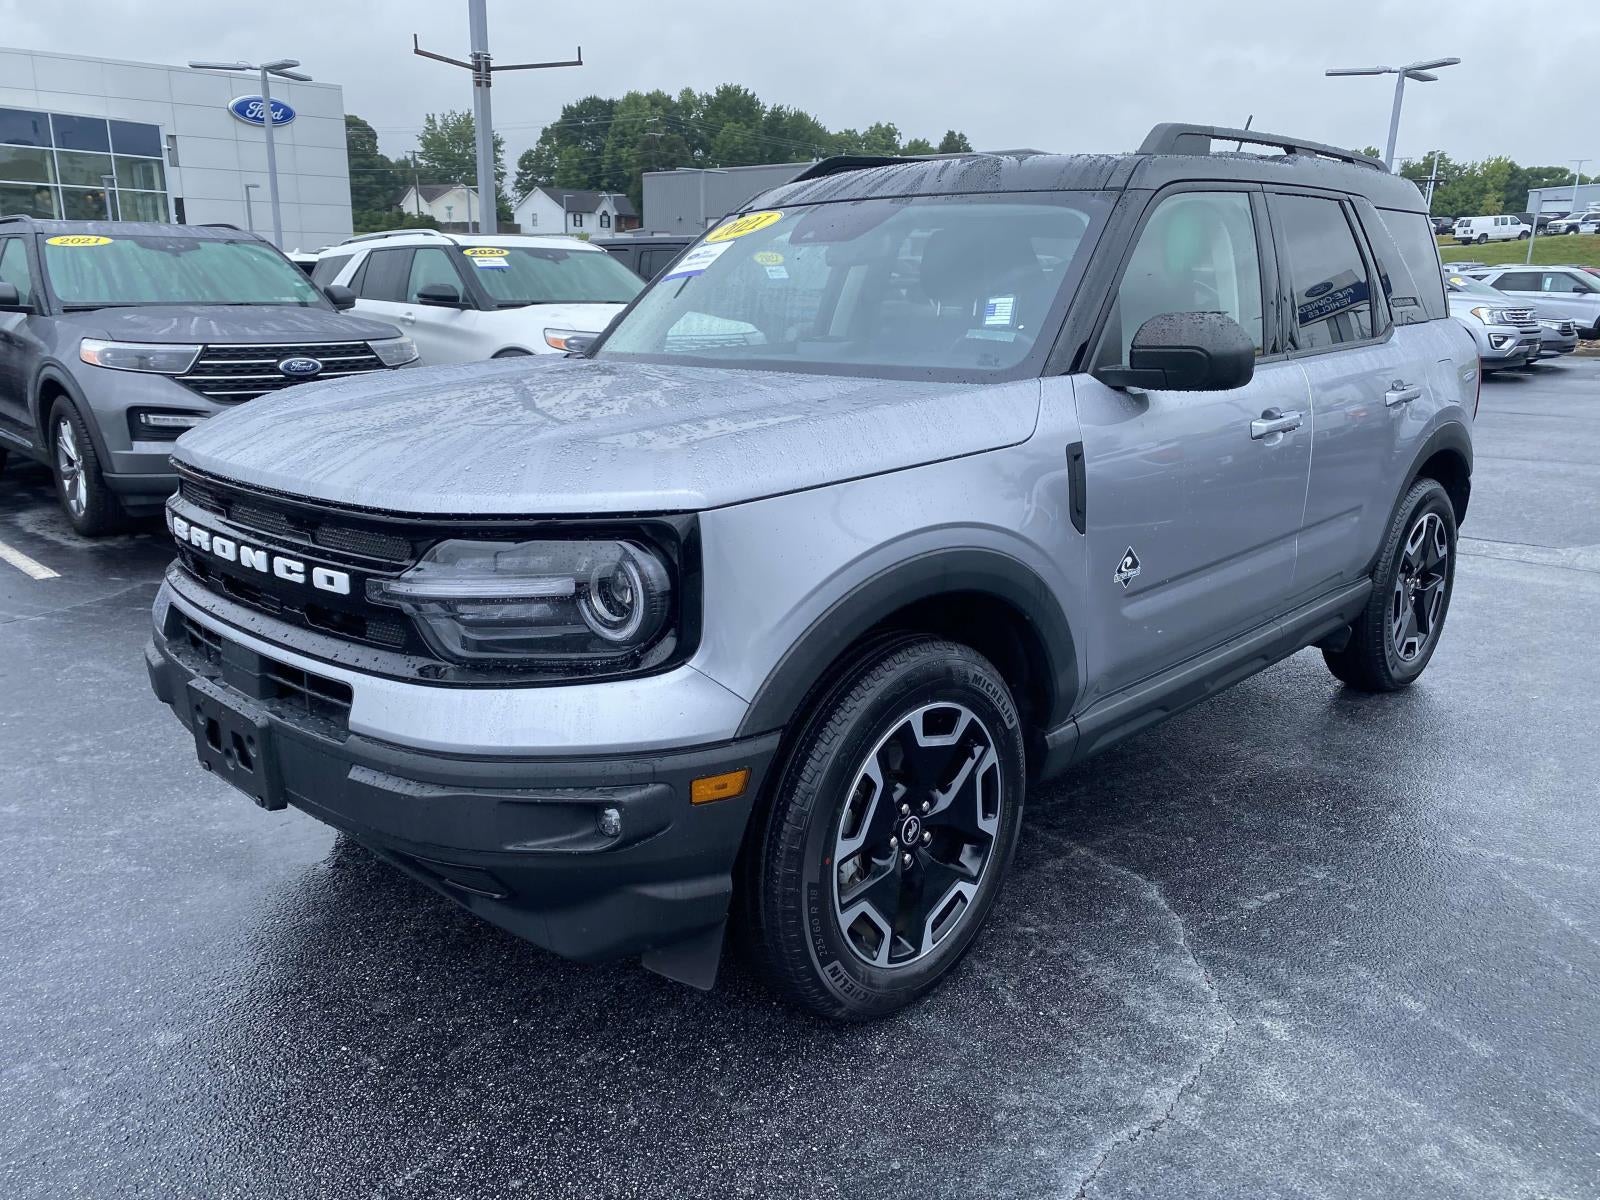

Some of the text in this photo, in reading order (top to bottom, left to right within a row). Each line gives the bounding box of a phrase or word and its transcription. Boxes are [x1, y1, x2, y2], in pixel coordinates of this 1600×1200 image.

[246, 101, 284, 120] Fod
[59, 237, 101, 245] 2021
[173, 516, 351, 596] BRONCO
[972, 672, 1016, 725] MICHELIN
